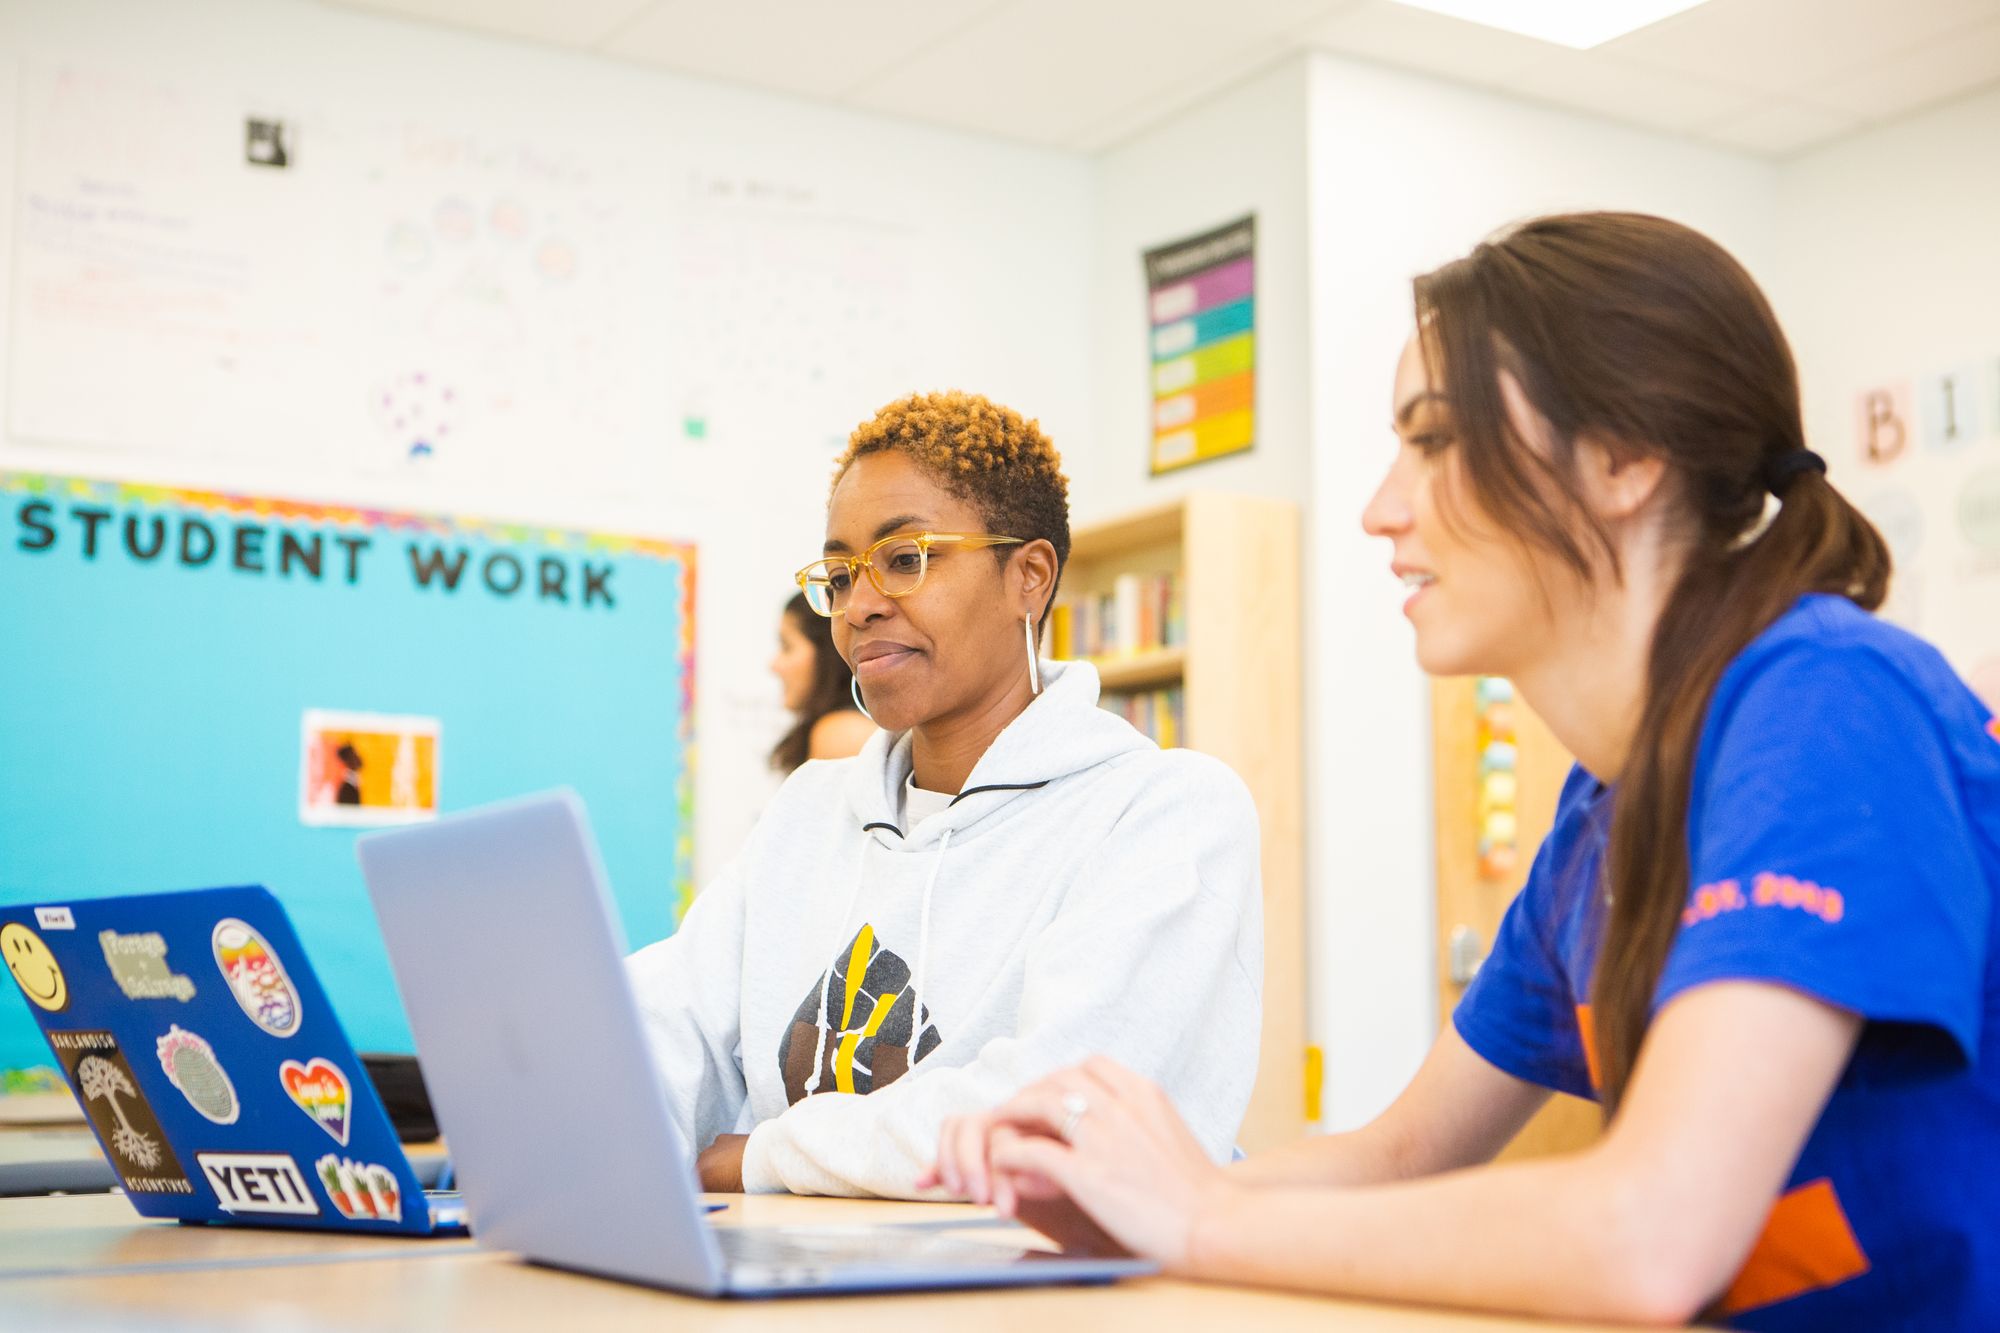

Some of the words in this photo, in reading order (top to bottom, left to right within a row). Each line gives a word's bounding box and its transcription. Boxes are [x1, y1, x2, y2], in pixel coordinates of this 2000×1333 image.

[18, 501, 371, 585] STUDENT
[408, 544, 618, 608] WORK
[51, 1033, 115, 1049] OAKLANDISH
[124, 1177, 192, 1194] OAKLANDISH
[207, 1166, 305, 1204] YETI
